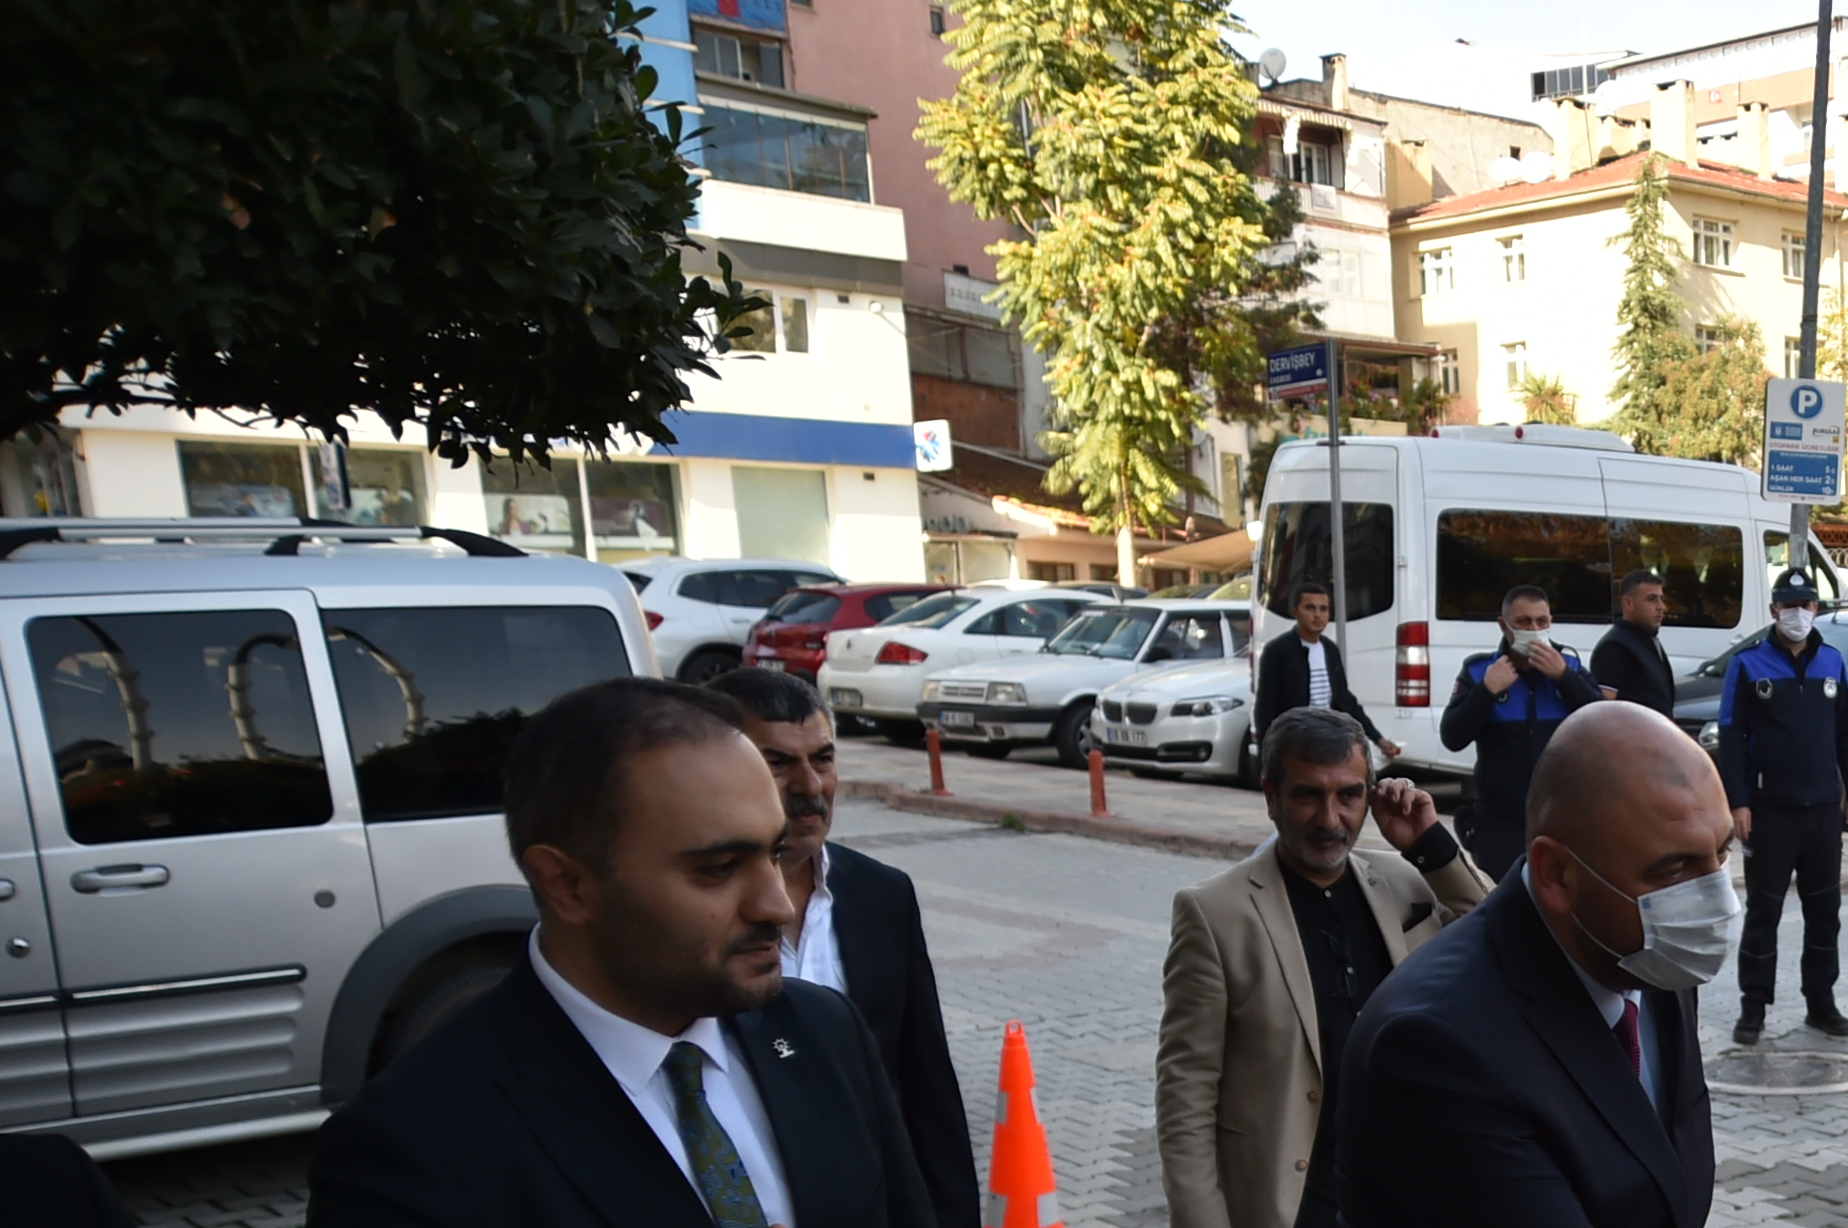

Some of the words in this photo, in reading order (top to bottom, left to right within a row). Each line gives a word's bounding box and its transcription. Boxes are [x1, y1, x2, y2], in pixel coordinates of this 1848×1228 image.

[1269, 352, 1315, 372] DERVİŞBEY
[1798, 389, 1818, 414] P
[1776, 464, 1795, 472] SAAT
[1769, 474, 1789, 483] AŞAN
[1790, 475, 1804, 483] HER
